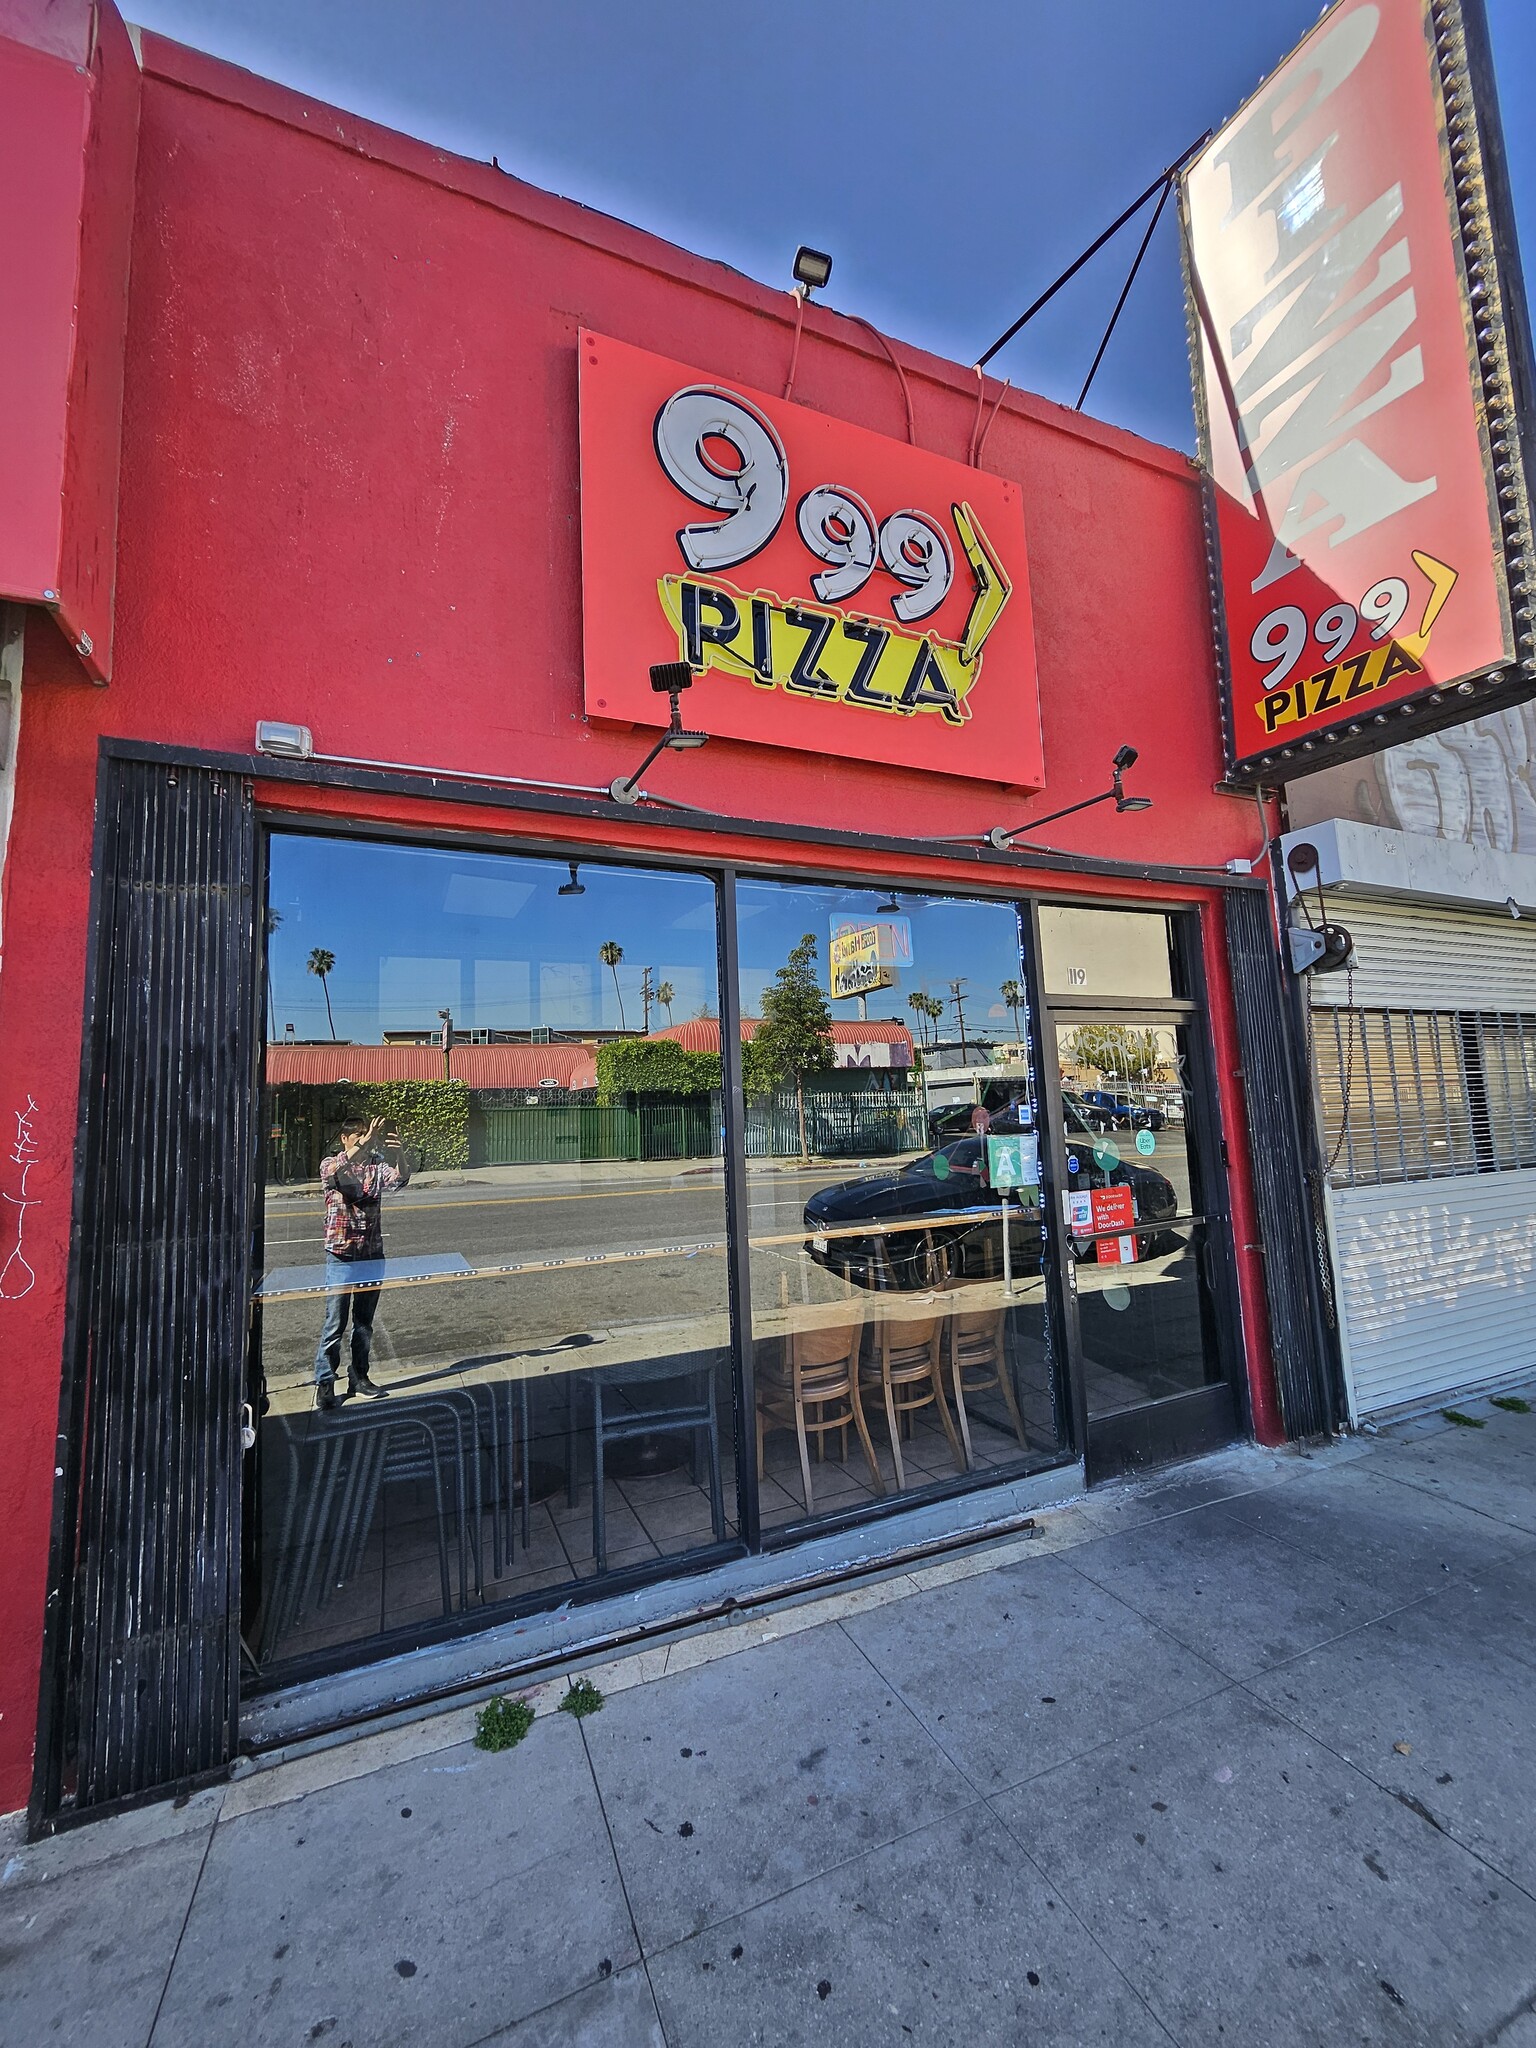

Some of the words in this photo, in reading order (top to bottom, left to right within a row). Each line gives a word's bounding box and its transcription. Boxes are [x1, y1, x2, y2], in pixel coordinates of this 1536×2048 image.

[1251, 576, 1409, 690] 999
[678, 580, 967, 725] PIZZA
[1263, 639, 1422, 733] PIZZA
[1068, 968, 1086, 985] 119
[996, 1146, 1017, 1176] A
[1097, 1213, 1109, 1221] with
[1106, 1203, 1125, 1211] deliver
[1097, 1219, 1125, 1230] DoorDash
